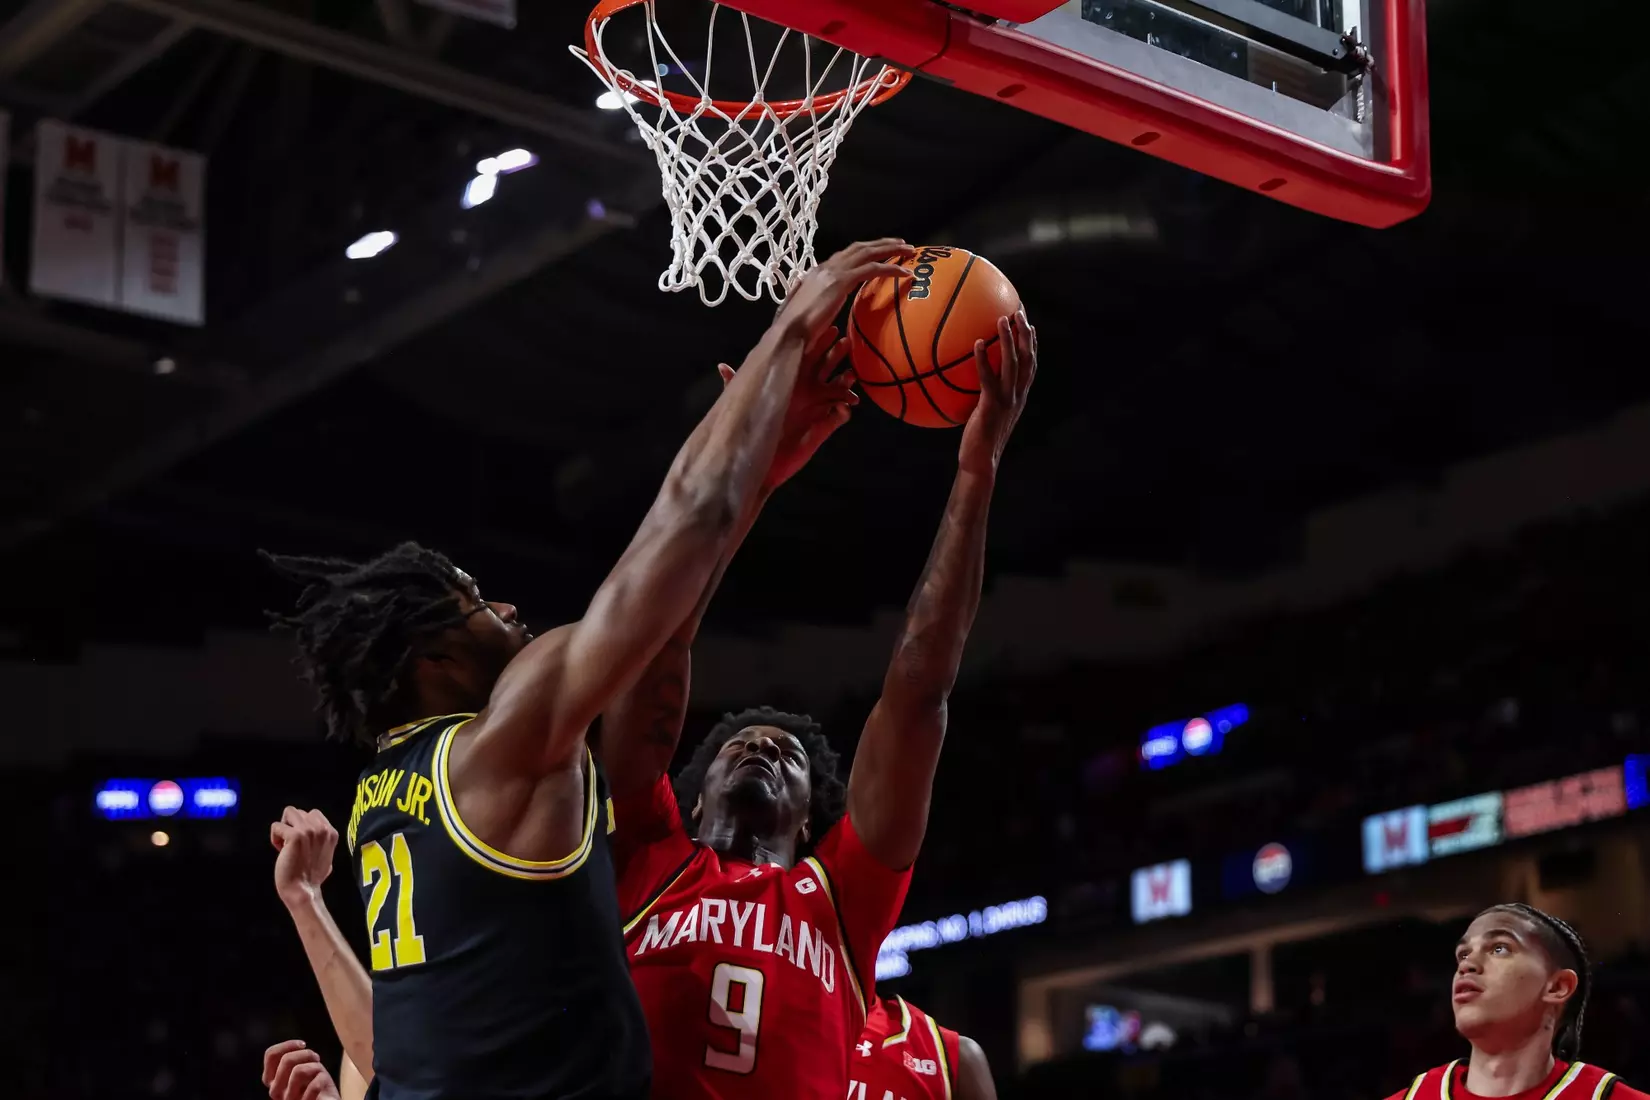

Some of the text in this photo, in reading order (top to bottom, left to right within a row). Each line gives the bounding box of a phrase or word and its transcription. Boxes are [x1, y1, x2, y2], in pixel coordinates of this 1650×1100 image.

[907, 246, 953, 301] ilson
[396, 771, 433, 826] JR.
[361, 832, 427, 971] 21
[634, 897, 835, 993] MARYLAND
[704, 962, 765, 1076] 9
